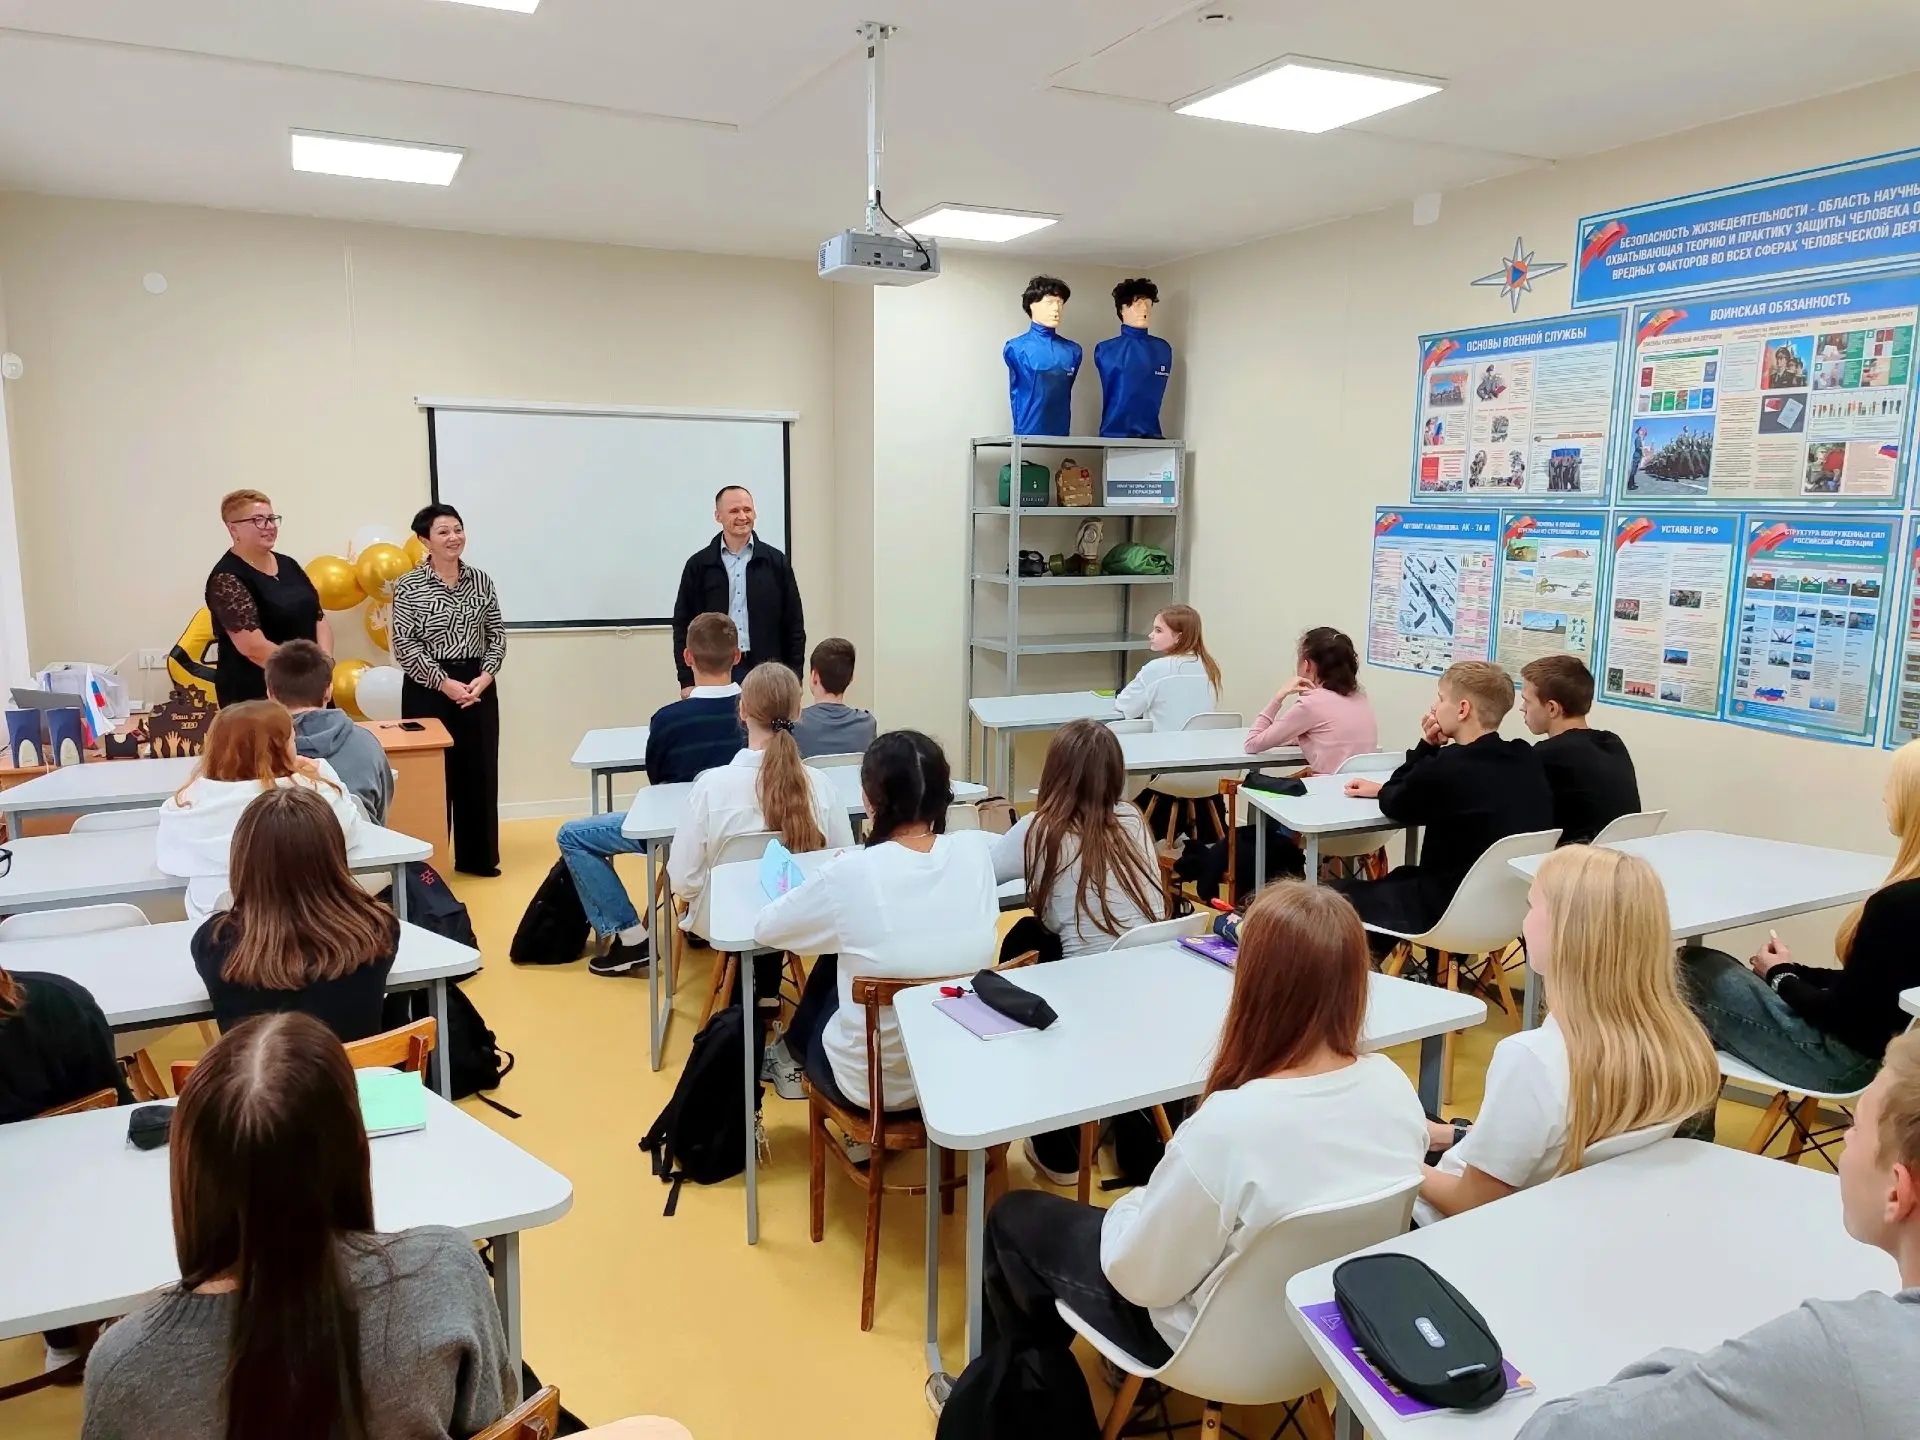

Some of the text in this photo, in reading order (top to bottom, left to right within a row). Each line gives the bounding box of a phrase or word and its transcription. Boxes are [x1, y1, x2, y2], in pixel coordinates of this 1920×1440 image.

[1620, 225, 1690, 249] БЕЗОПАСНОСТЬ
[1692, 203, 1809, 236] ЖИЗНЕДЕЯТЕЛЬНОСТИ
[1818, 193, 1870, 213] ОБЛАСТЬ
[1605, 243, 1683, 267] ОХВАТЫВАЮЩАЯ
[1685, 235, 1726, 253] ТЕОРИЮ
[1728, 234, 1736, 246] И
[1738, 222, 1792, 245] ПРАКТИКУ
[1795, 214, 1846, 234] ЗАЩИТЫ
[1849, 203, 1909, 225] ЧЕЛОВЕКА
[1612, 263, 1655, 281] ВРЕДНЫХ
[1657, 255, 1709, 273] ФАКТОРОВ
[1711, 252, 1725, 265] ВО
[1727, 246, 1752, 262] ВСЕХ
[1754, 239, 1798, 258] СФЕРАХ
[1801, 223, 1889, 250] ЧЕЛОВЕЧЕСКОЙ
[1710, 292, 1851, 321] ВОИНСКАЯ ОБЯЗАННОСТЬ
[1466, 327, 1587, 352] ОСНОВЫ ВОЕННОЙ СЛУЖБЫ
[1461, 523, 1470, 532] АК
[1661, 525, 1719, 535] УСТАВЫ ВС РФ
[1784, 528, 1885, 539] СТРУКТУРА ВООРУЖЕННЫХ СИЛ
[1793, 537, 1874, 547] РОССИЙСКОЙ ФЕДЕРАЦИИ
